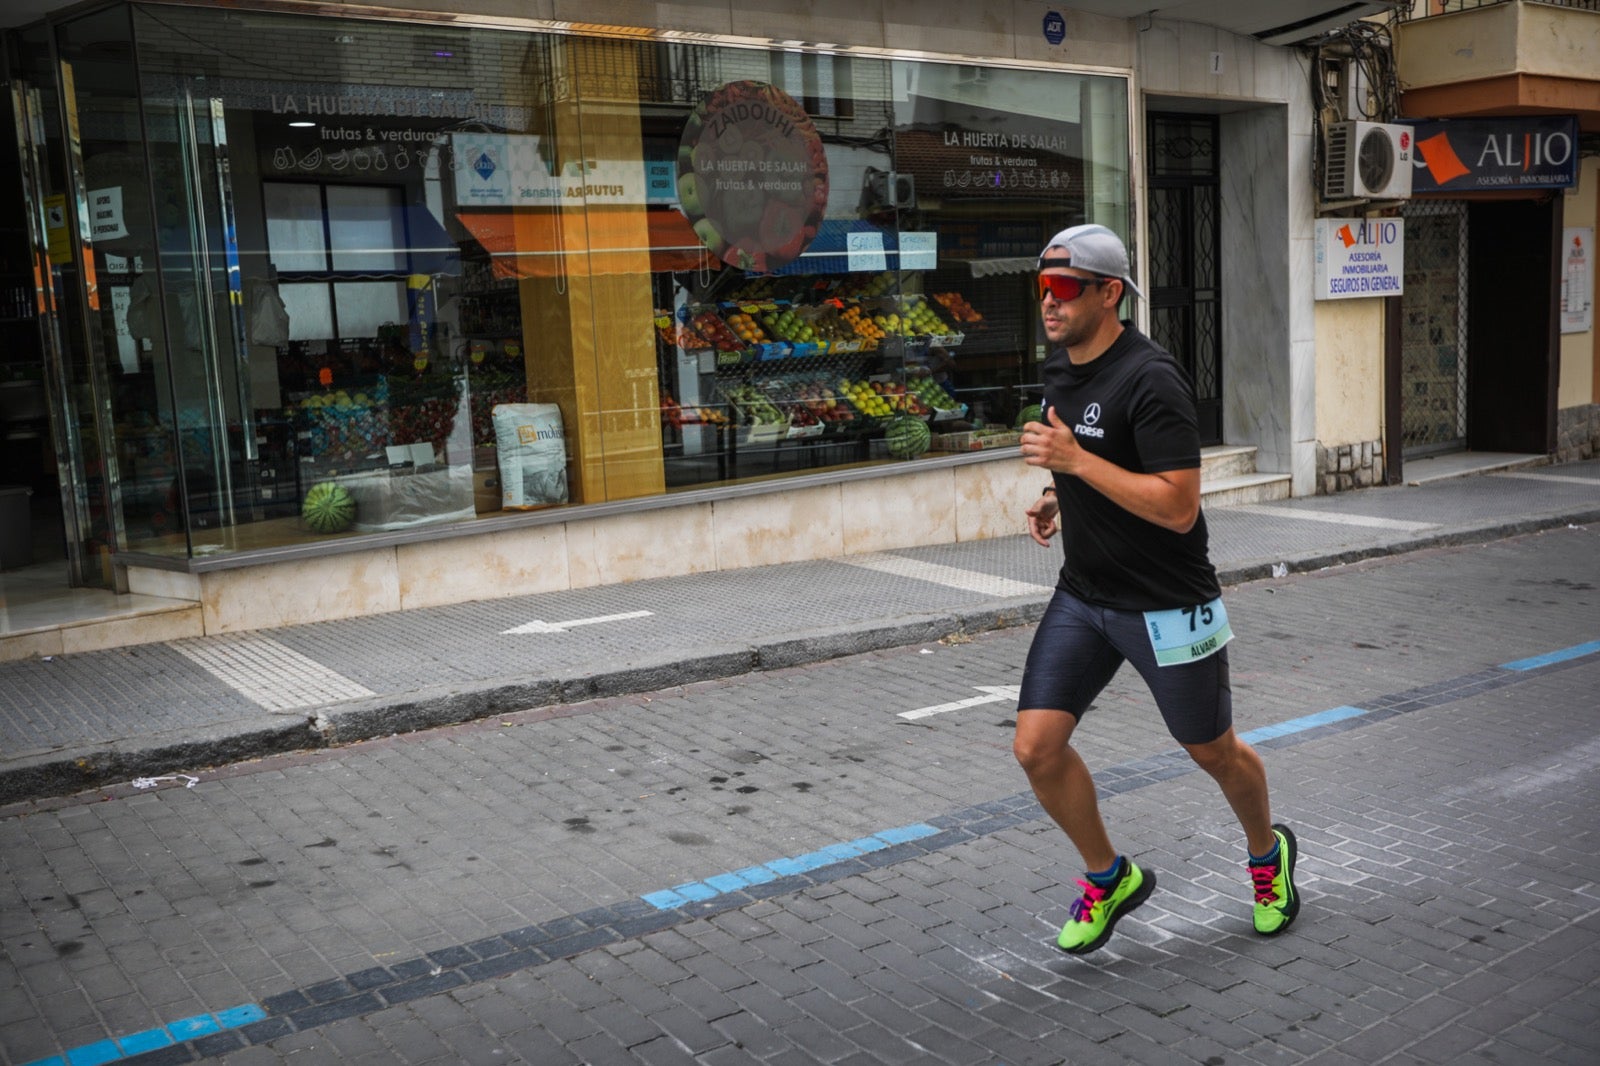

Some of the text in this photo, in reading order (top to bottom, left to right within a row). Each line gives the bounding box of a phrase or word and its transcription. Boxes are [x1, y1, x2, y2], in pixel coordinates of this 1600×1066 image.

[1047, 21, 1062, 32] ADT
[1214, 55, 1220, 71] 1
[271, 94, 299, 114] LA
[305, 95, 389, 116] HUERTA
[709, 103, 797, 138] ZAIDOUHI
[321, 126, 440, 142] frutas & verduras
[944, 131, 1067, 150] LA HUERTA DE SALAH
[1400, 152, 1408, 161] LG
[1476, 131, 1572, 173] ALJIO
[701, 160, 807, 173] LA HUERTA DE SALAH
[970, 155, 1038, 167] frutas & verduras
[716, 179, 802, 191] frutas & verduras
[1356, 222, 1397, 248] ALJIO
[1349, 251, 1381, 262] ASESORÍA
[1342, 264, 1388, 275] INMOBILIARIA
[1330, 276, 1400, 293] SEGUROS EN GENERAL
[1181, 602, 1213, 632] 75
